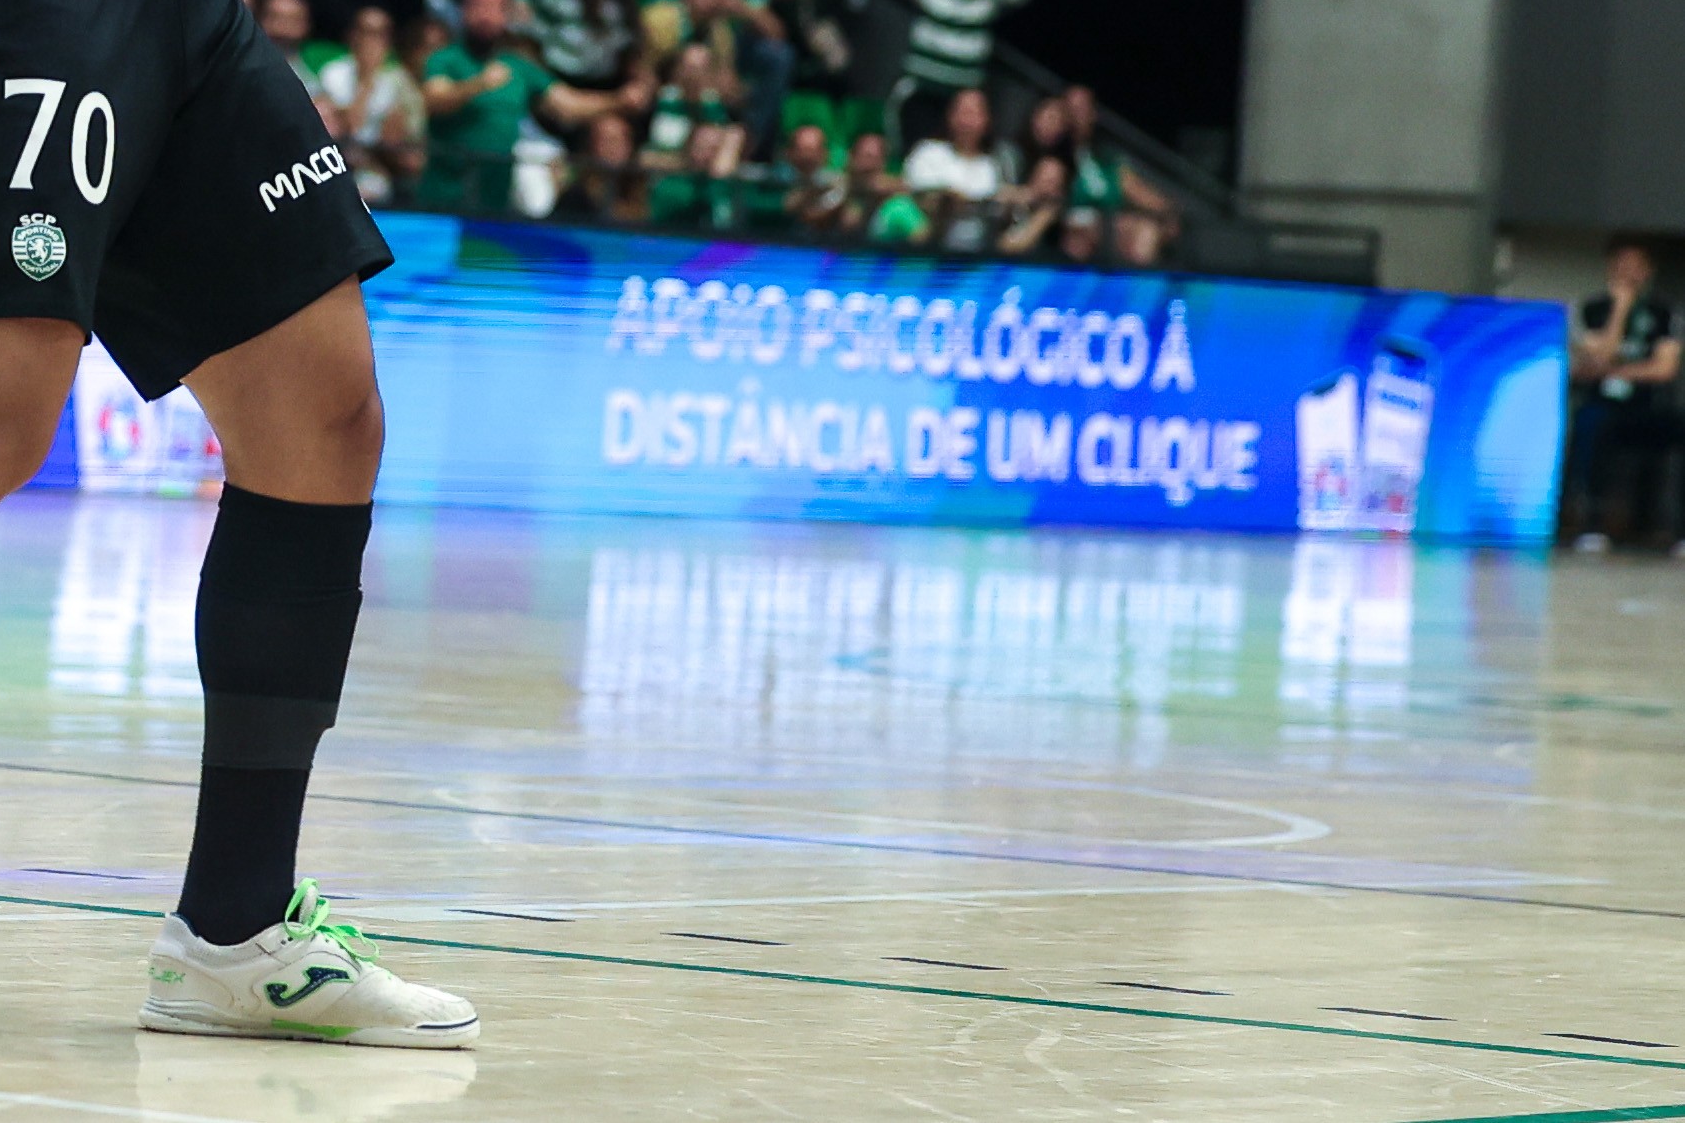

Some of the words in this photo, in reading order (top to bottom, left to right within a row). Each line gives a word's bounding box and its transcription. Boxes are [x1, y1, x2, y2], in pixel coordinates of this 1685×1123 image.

[3, 79, 115, 205] 70
[19, 212, 57, 227] SCP
[905, 407, 979, 484] DE
[986, 407, 1073, 482] UM
[1076, 411, 1261, 507] CLIQUE
